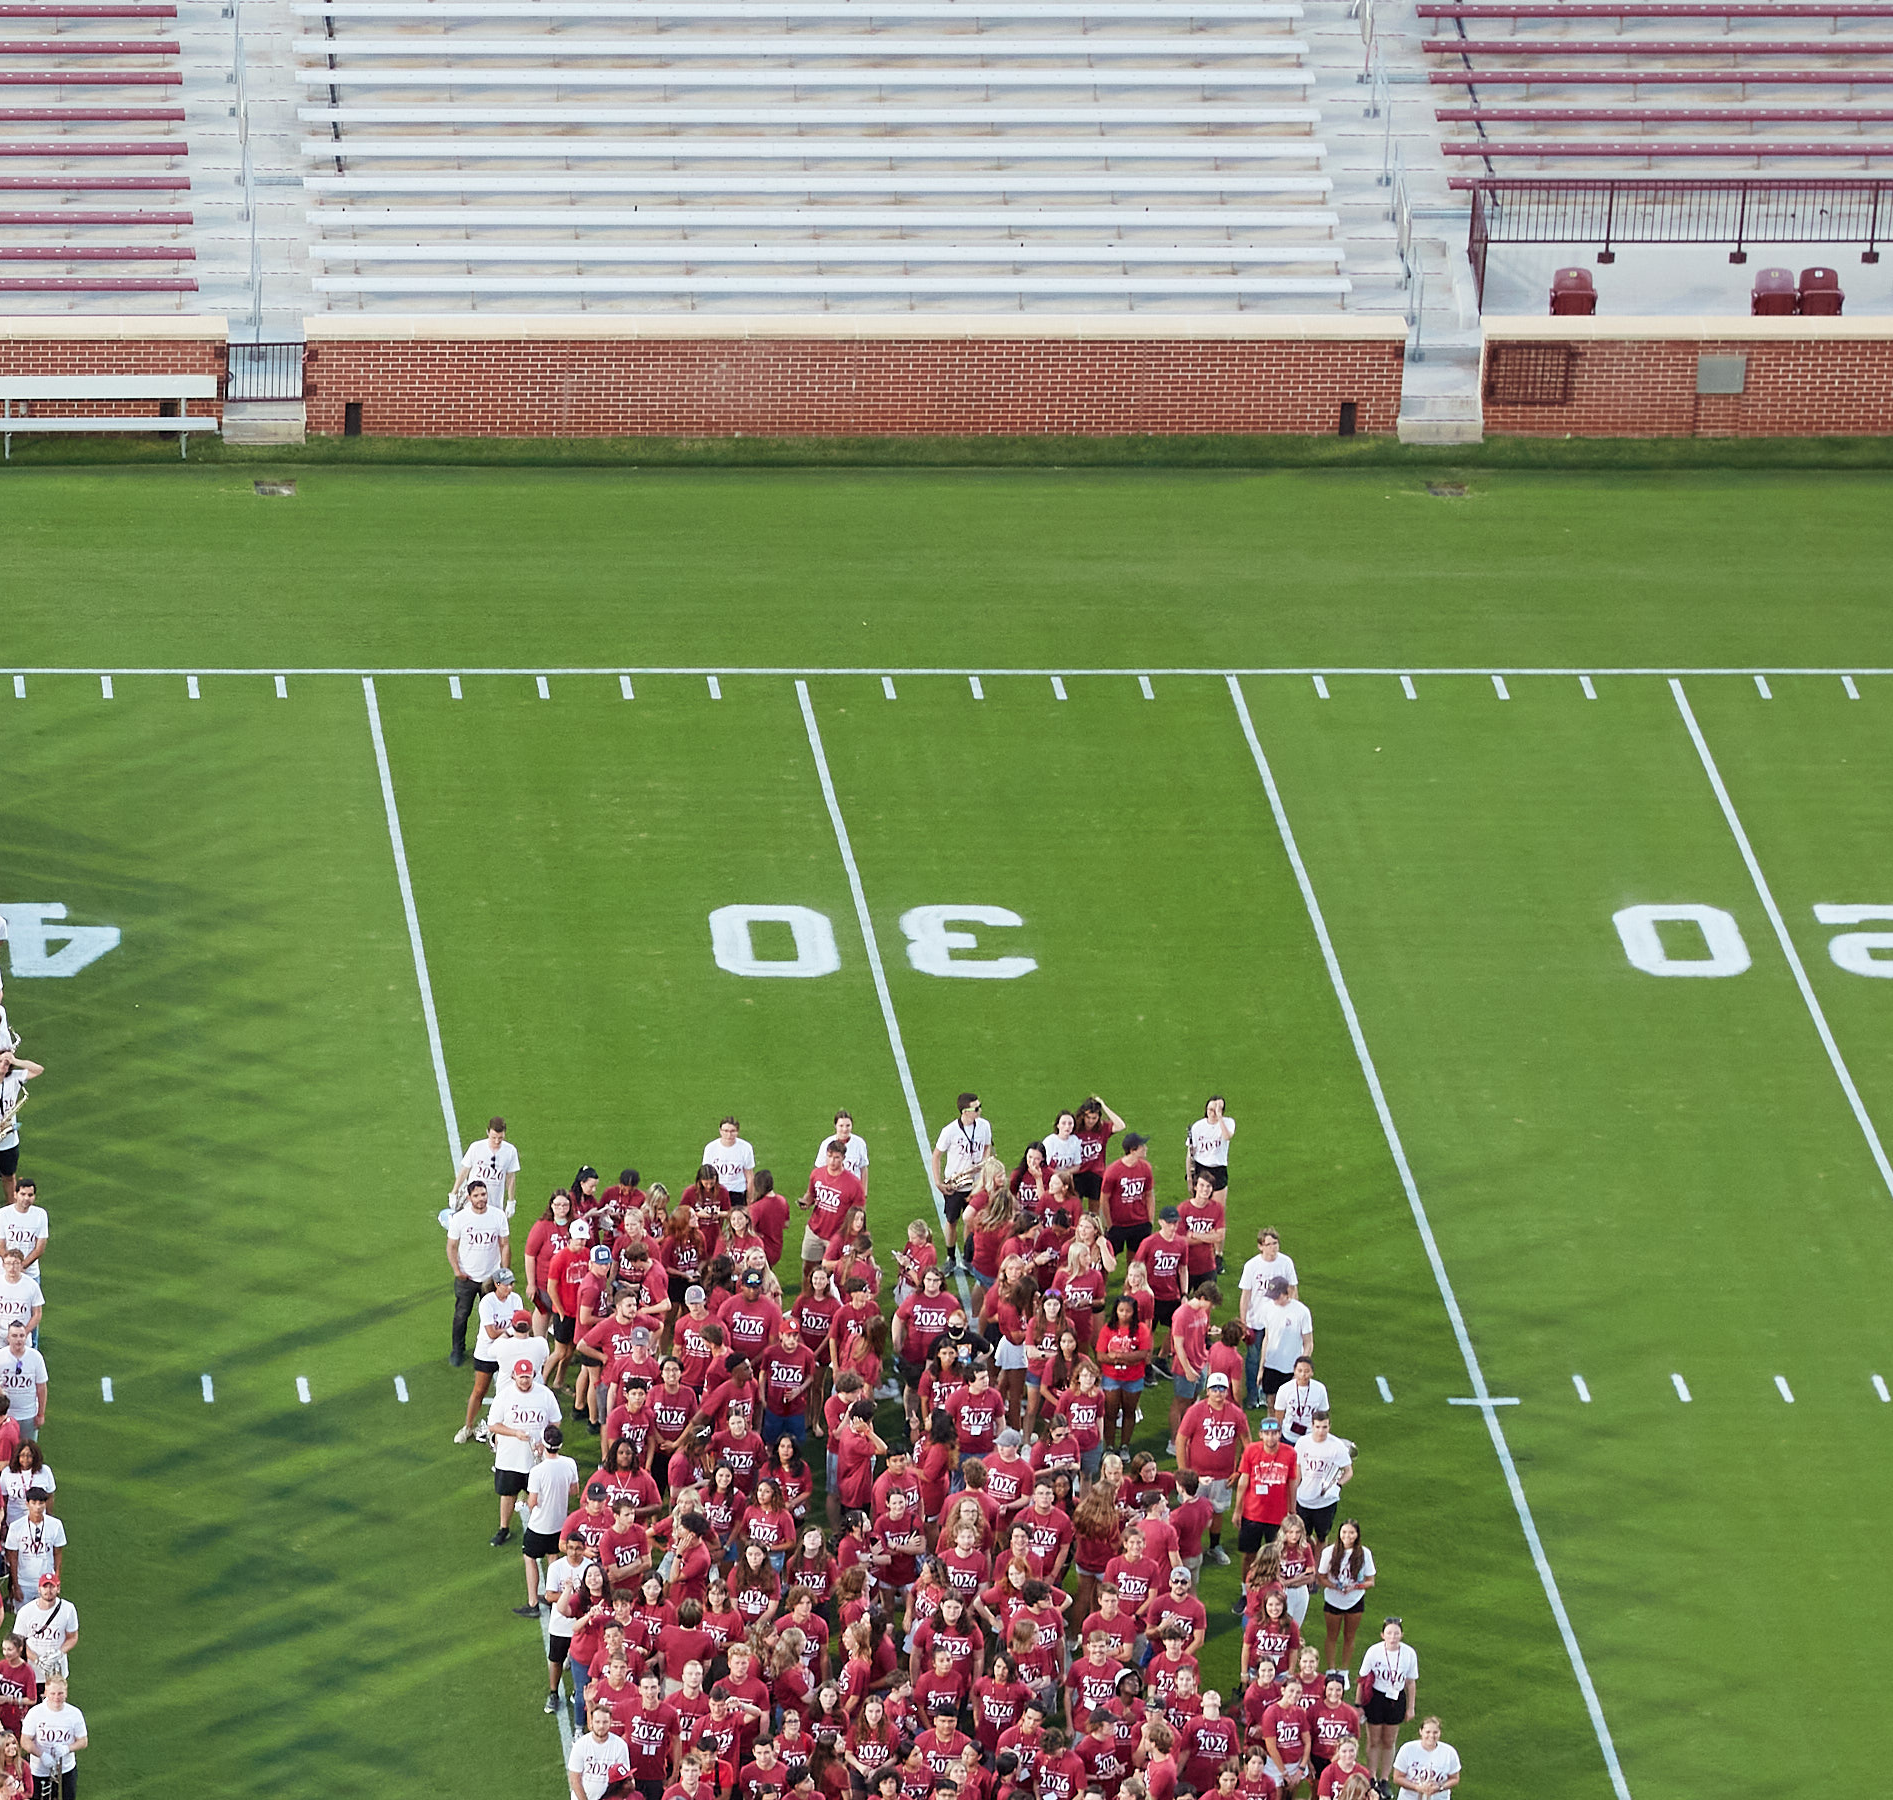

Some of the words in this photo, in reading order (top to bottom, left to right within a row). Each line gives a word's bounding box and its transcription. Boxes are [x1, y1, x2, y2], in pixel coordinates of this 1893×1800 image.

[10, 1230, 37, 1243] 2026
[469, 1232, 497, 1244] 2026
[913, 1311, 947, 1326] 2026
[732, 1319, 764, 1334] 2026
[770, 1368, 803, 1382] 2026
[514, 1411, 544, 1423] 2026
[40, 1728, 71, 1742] 2026
